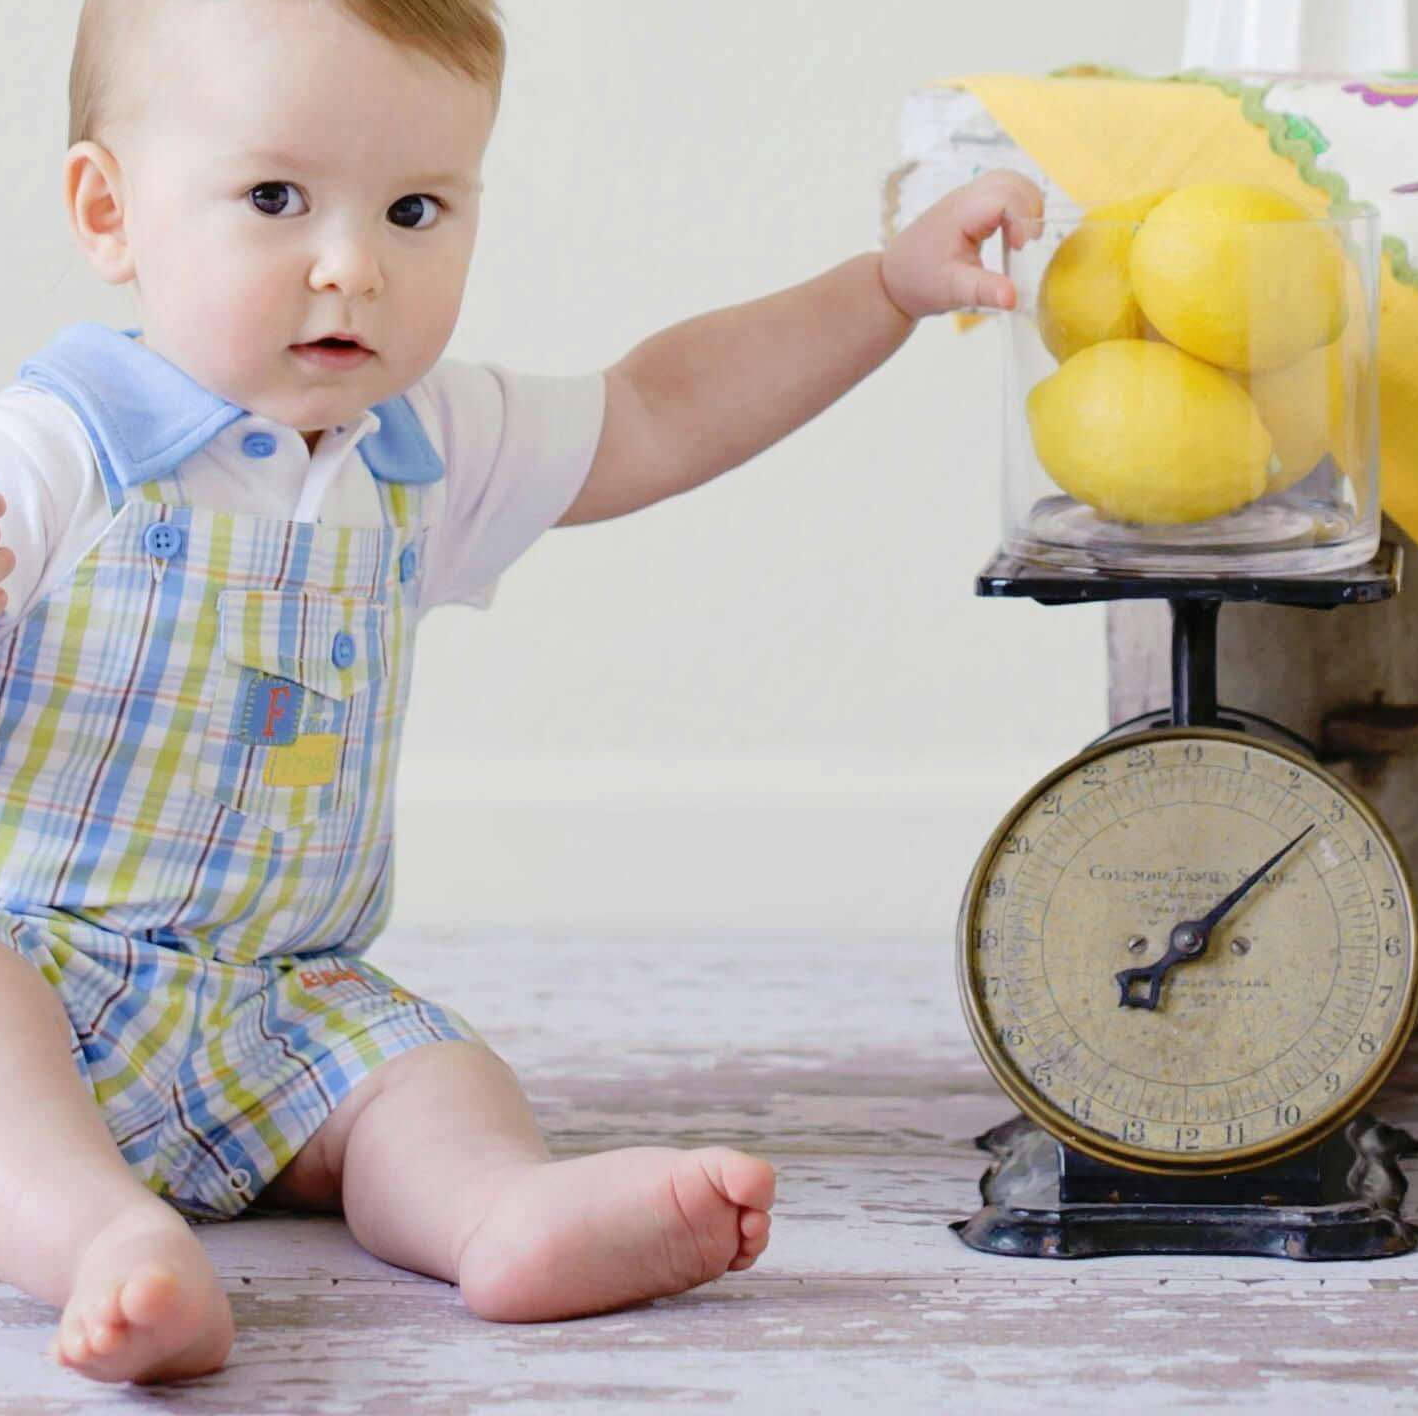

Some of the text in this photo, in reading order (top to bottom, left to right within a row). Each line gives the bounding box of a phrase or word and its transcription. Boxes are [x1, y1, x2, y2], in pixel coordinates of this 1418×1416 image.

[262, 685, 292, 737] F
[1184, 744, 1203, 763] 0
[1242, 751, 1251, 771] 1
[1288, 768, 1301, 790] 2
[1331, 799, 1346, 823] 3
[1004, 836, 1030, 855] 20
[1359, 839, 1373, 862] 4
[1380, 888, 1396, 910] 5
[1384, 936, 1401, 958] 6
[1378, 984, 1393, 1008] 7
[1357, 1032, 1375, 1055] 8
[1324, 1072, 1341, 1094] 9
[1274, 1103, 1301, 1127] 10
[1122, 1120, 1145, 1143] 13
[1174, 1127, 1200, 1151] 12
[1224, 1121, 1244, 1145] 11
